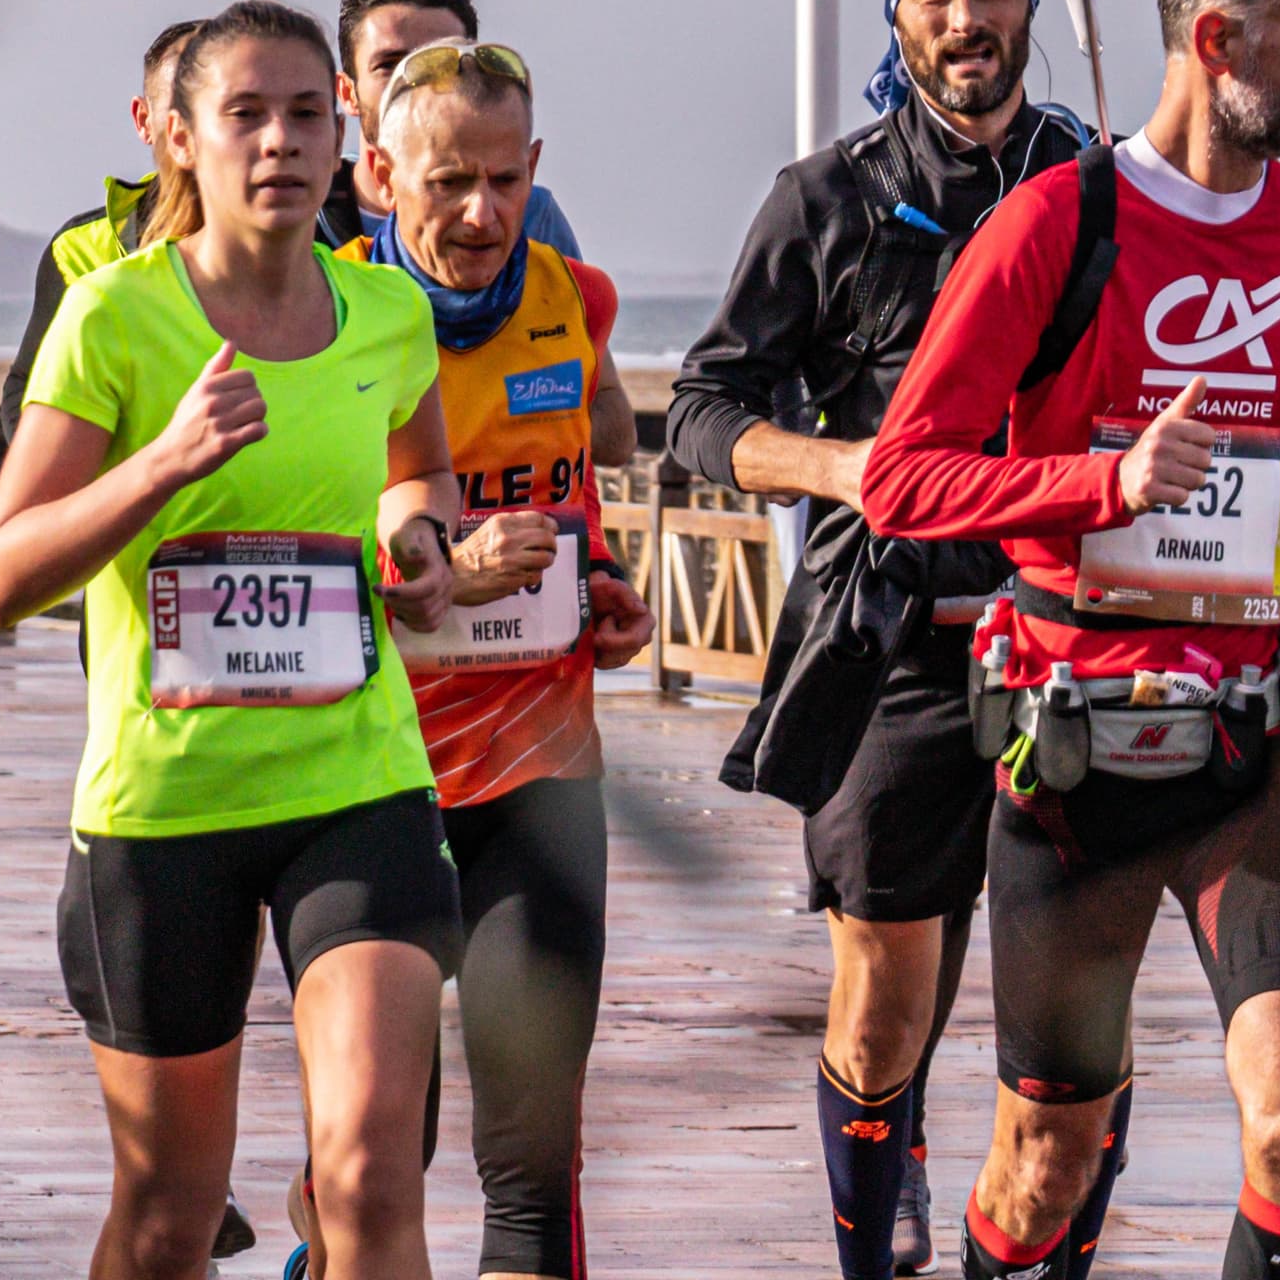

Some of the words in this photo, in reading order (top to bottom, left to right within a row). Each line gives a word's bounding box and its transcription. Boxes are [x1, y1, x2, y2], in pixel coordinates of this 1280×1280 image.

[1137, 396, 1273, 418] NOMANDIE
[549, 448, 587, 504] 91
[226, 535, 298, 544] Marathon
[226, 543, 298, 552] International
[1156, 538, 1225, 562] ARNAUD
[157, 575, 177, 632] CLIF
[212, 574, 312, 629] 2357
[1243, 597, 1280, 620] 2252
[472, 619, 523, 642] HERVE
[226, 651, 305, 674] MELANIE
[455, 654, 473, 666] VIRY
